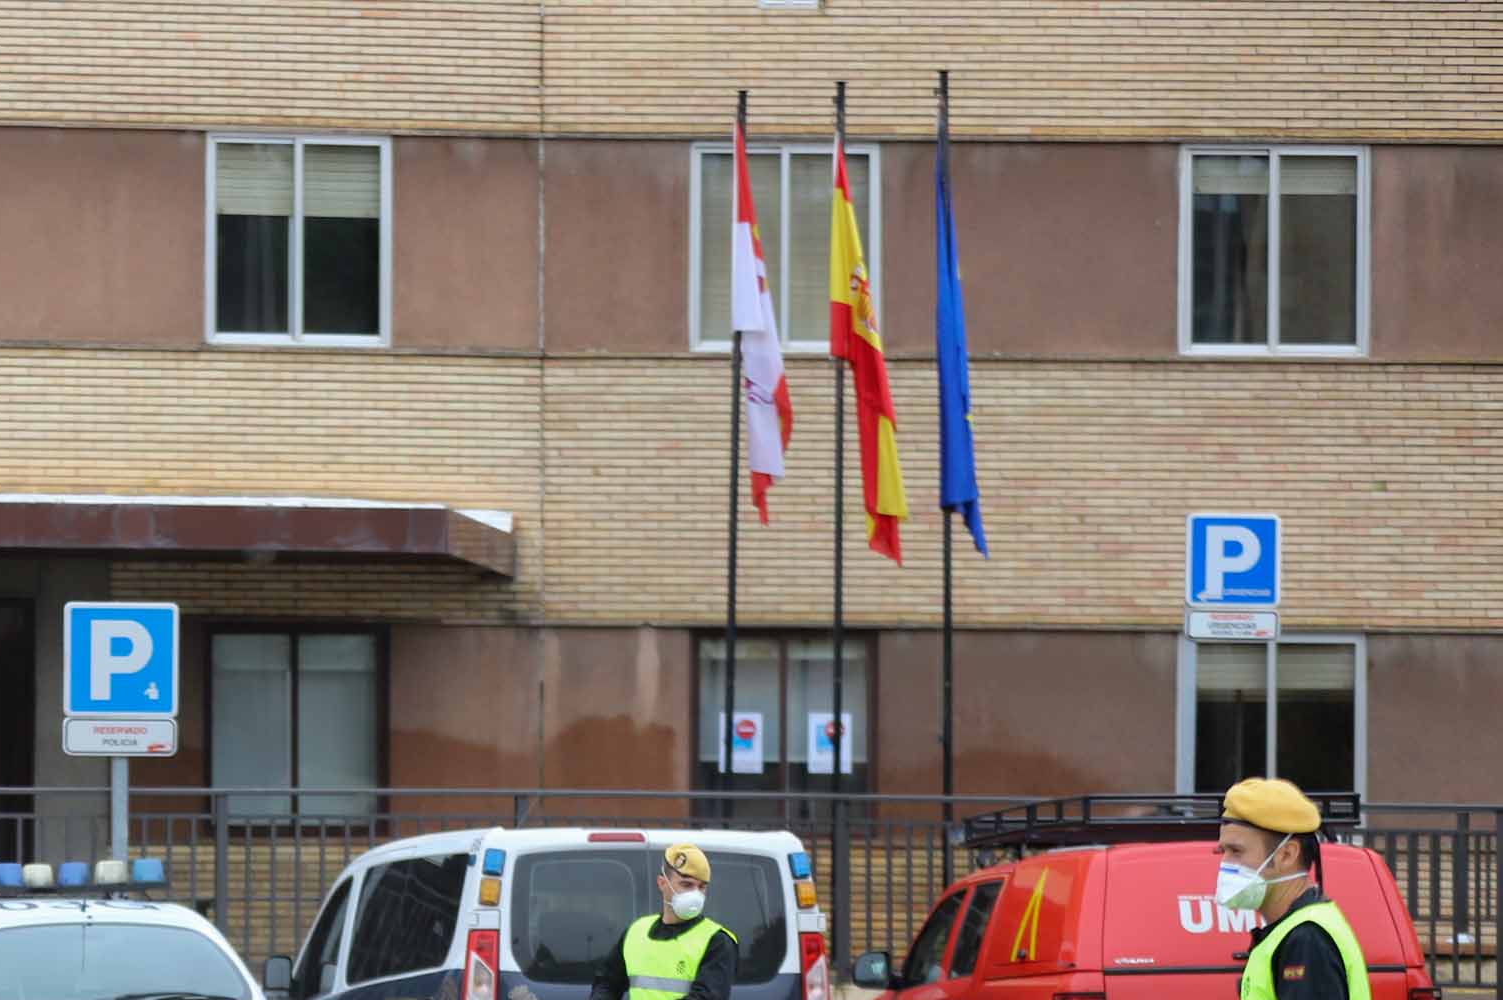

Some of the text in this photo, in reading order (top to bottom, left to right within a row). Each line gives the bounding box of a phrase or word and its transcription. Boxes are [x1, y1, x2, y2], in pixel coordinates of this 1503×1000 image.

[1205, 525, 1262, 598] P
[90, 619, 154, 701] P
[1179, 899, 1267, 933] UM
